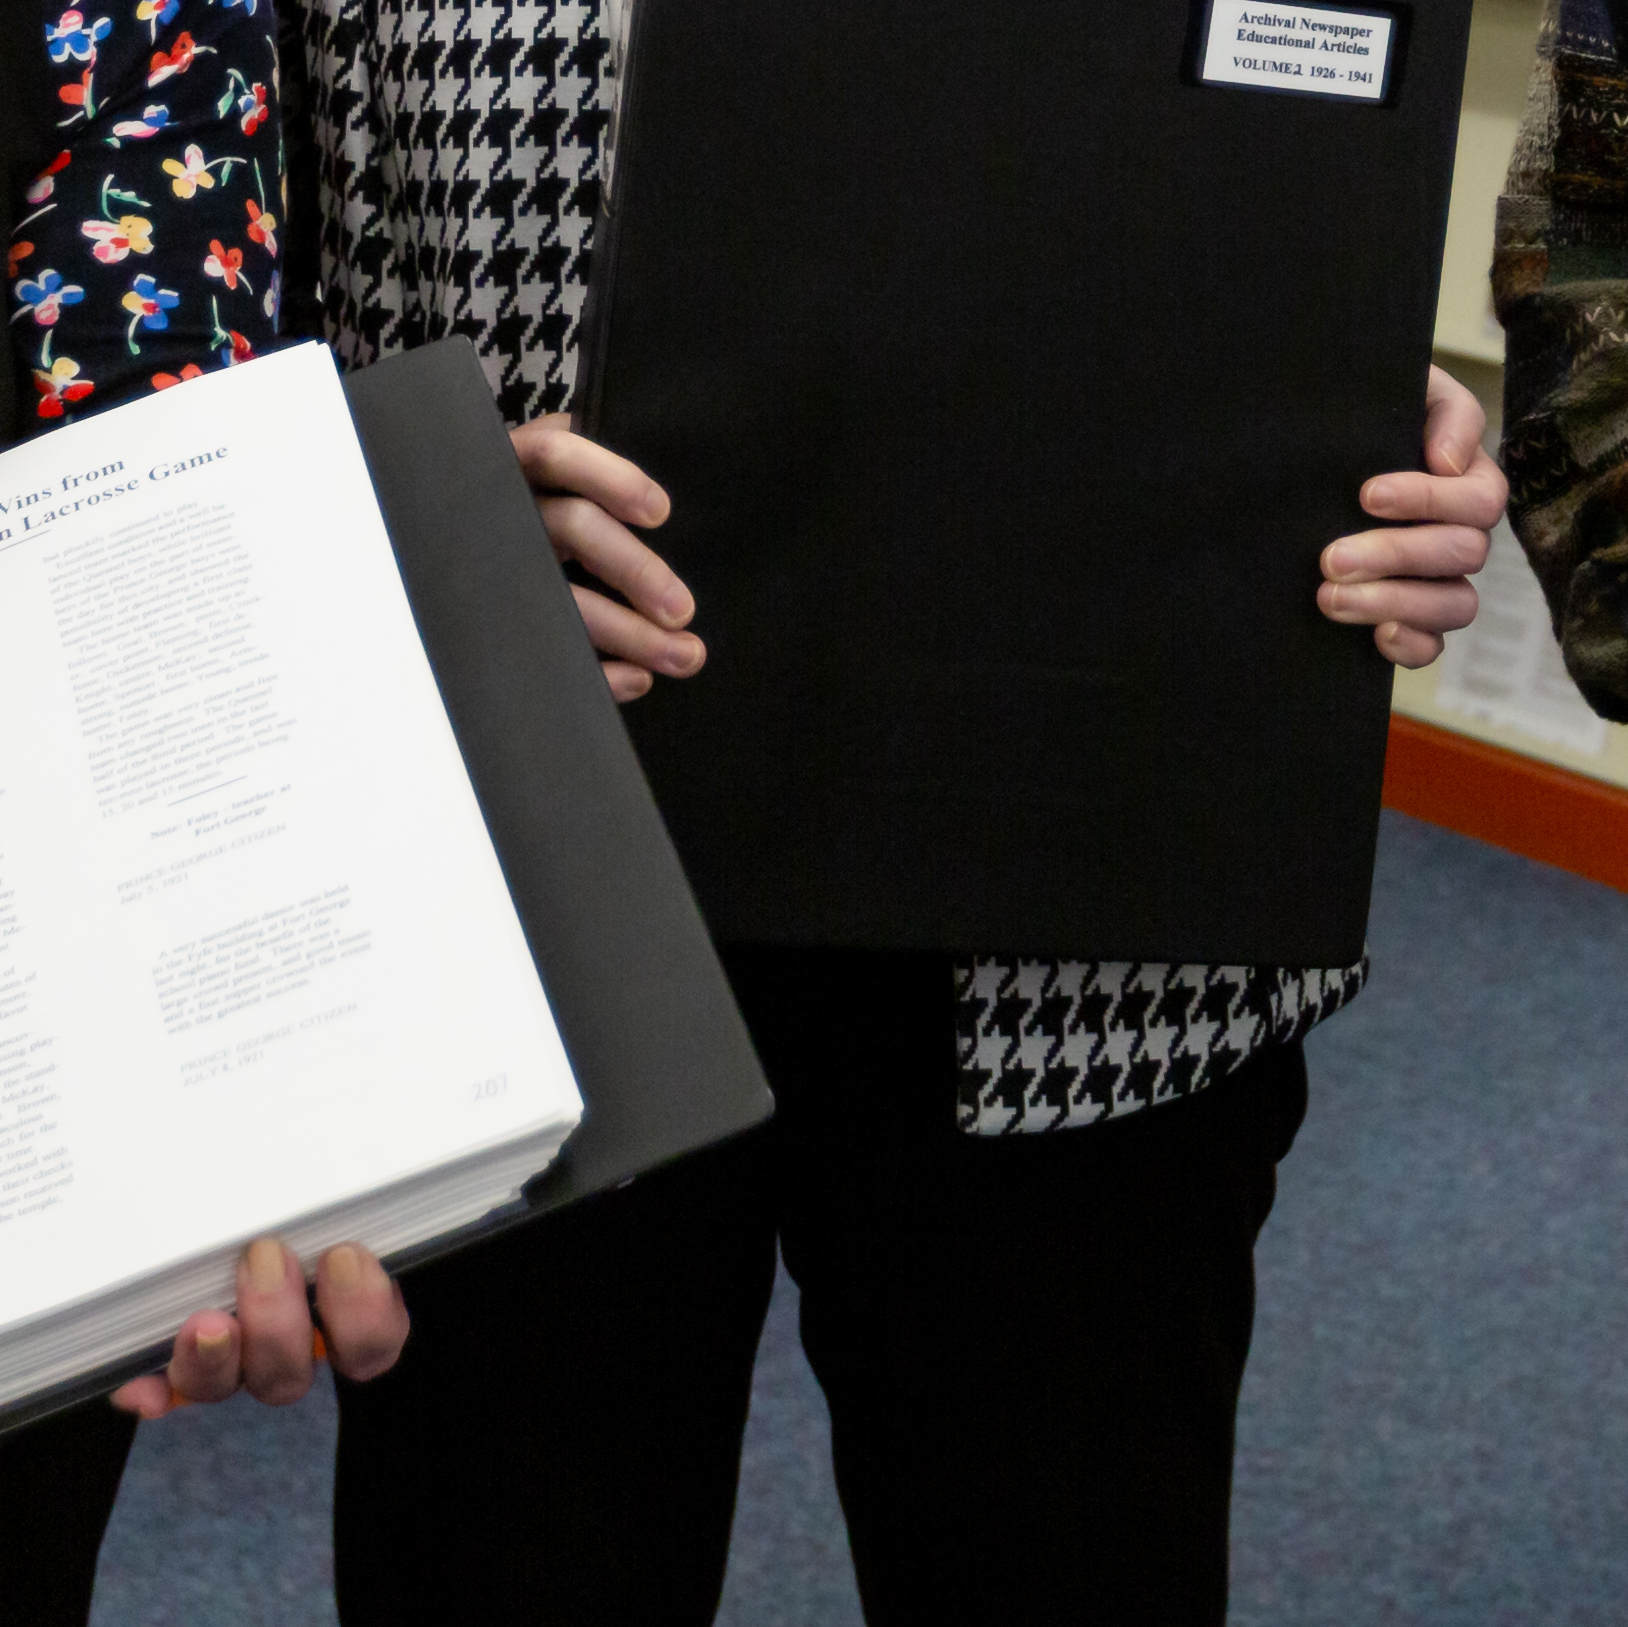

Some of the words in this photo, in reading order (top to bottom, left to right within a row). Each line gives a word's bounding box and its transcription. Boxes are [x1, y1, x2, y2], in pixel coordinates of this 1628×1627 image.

[1239, 11, 1296, 29] Archival
[1300, 18, 1373, 39] Newspaper
[1236, 29, 1316, 49] Educational
[1319, 38, 1370, 56] Articles
[1233, 56, 1293, 74] VOLUME
[1310, 65, 1336, 79] 1926
[1348, 70, 1373, 84] 1941
[22, 476, 141, 532] Lacrosse
[148, 447, 230, 483] Game
[61, 458, 126, 492] from
[149, 823, 182, 839] Note:
[186, 809, 220, 826] Foley
[231, 790, 277, 809] teacher
[280, 783, 292, 793] at
[194, 821, 222, 837] Fort
[224, 805, 268, 825] George
[116, 866, 168, 892] PRINCE
[170, 844, 229, 872] GEORGE
[230, 823, 287, 849] CITIZEN
[119, 889, 144, 905] July
[147, 883, 159, 894] 5,
[162, 872, 190, 889] 1921
[179, 1047, 233, 1073] PRINCE
[236, 1024, 296, 1052] GEORGE
[299, 1001, 358, 1028] CITIZEN
[470, 1073, 507, 1101] 207
